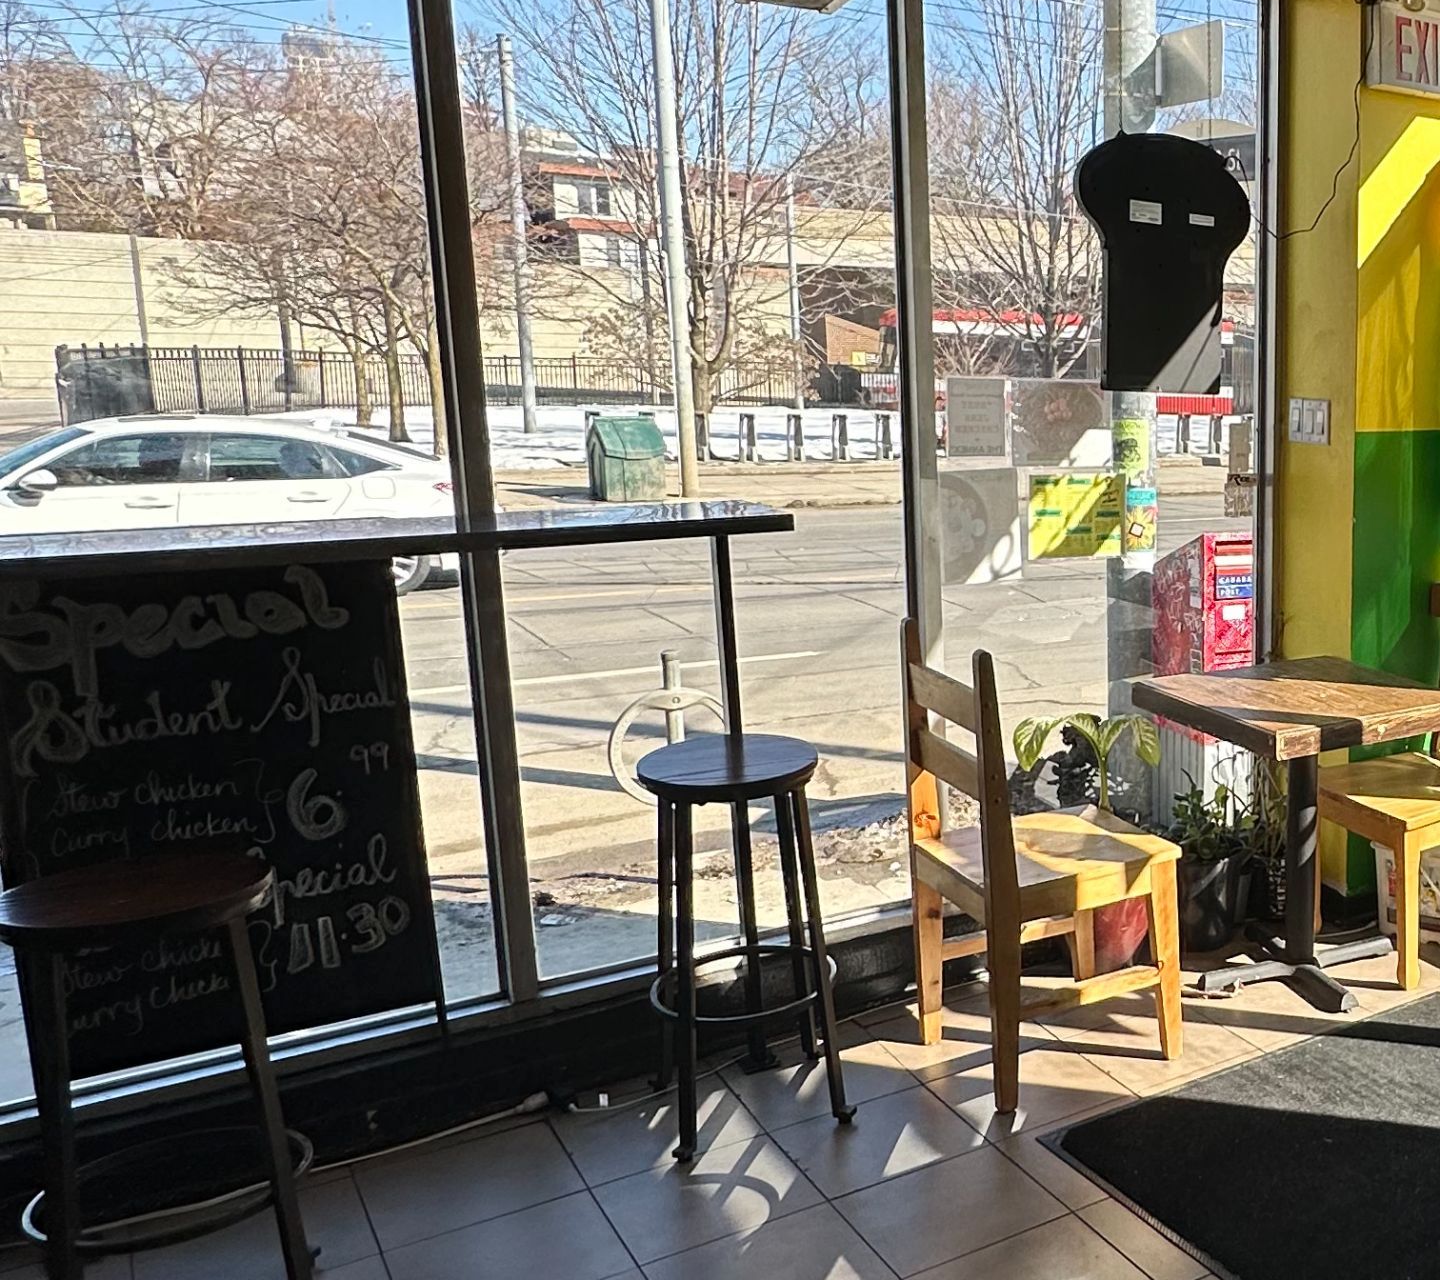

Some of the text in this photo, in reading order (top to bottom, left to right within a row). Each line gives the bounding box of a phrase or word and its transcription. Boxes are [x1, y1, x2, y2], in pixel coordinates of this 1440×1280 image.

[0, 565, 350, 697] Special
[10, 646, 396, 777] Student Special
[349, 740, 390, 775] 99
[51, 827, 130, 859] Curry
[287, 895, 411, 975] 11.30
[68, 993, 144, 1037] urry
